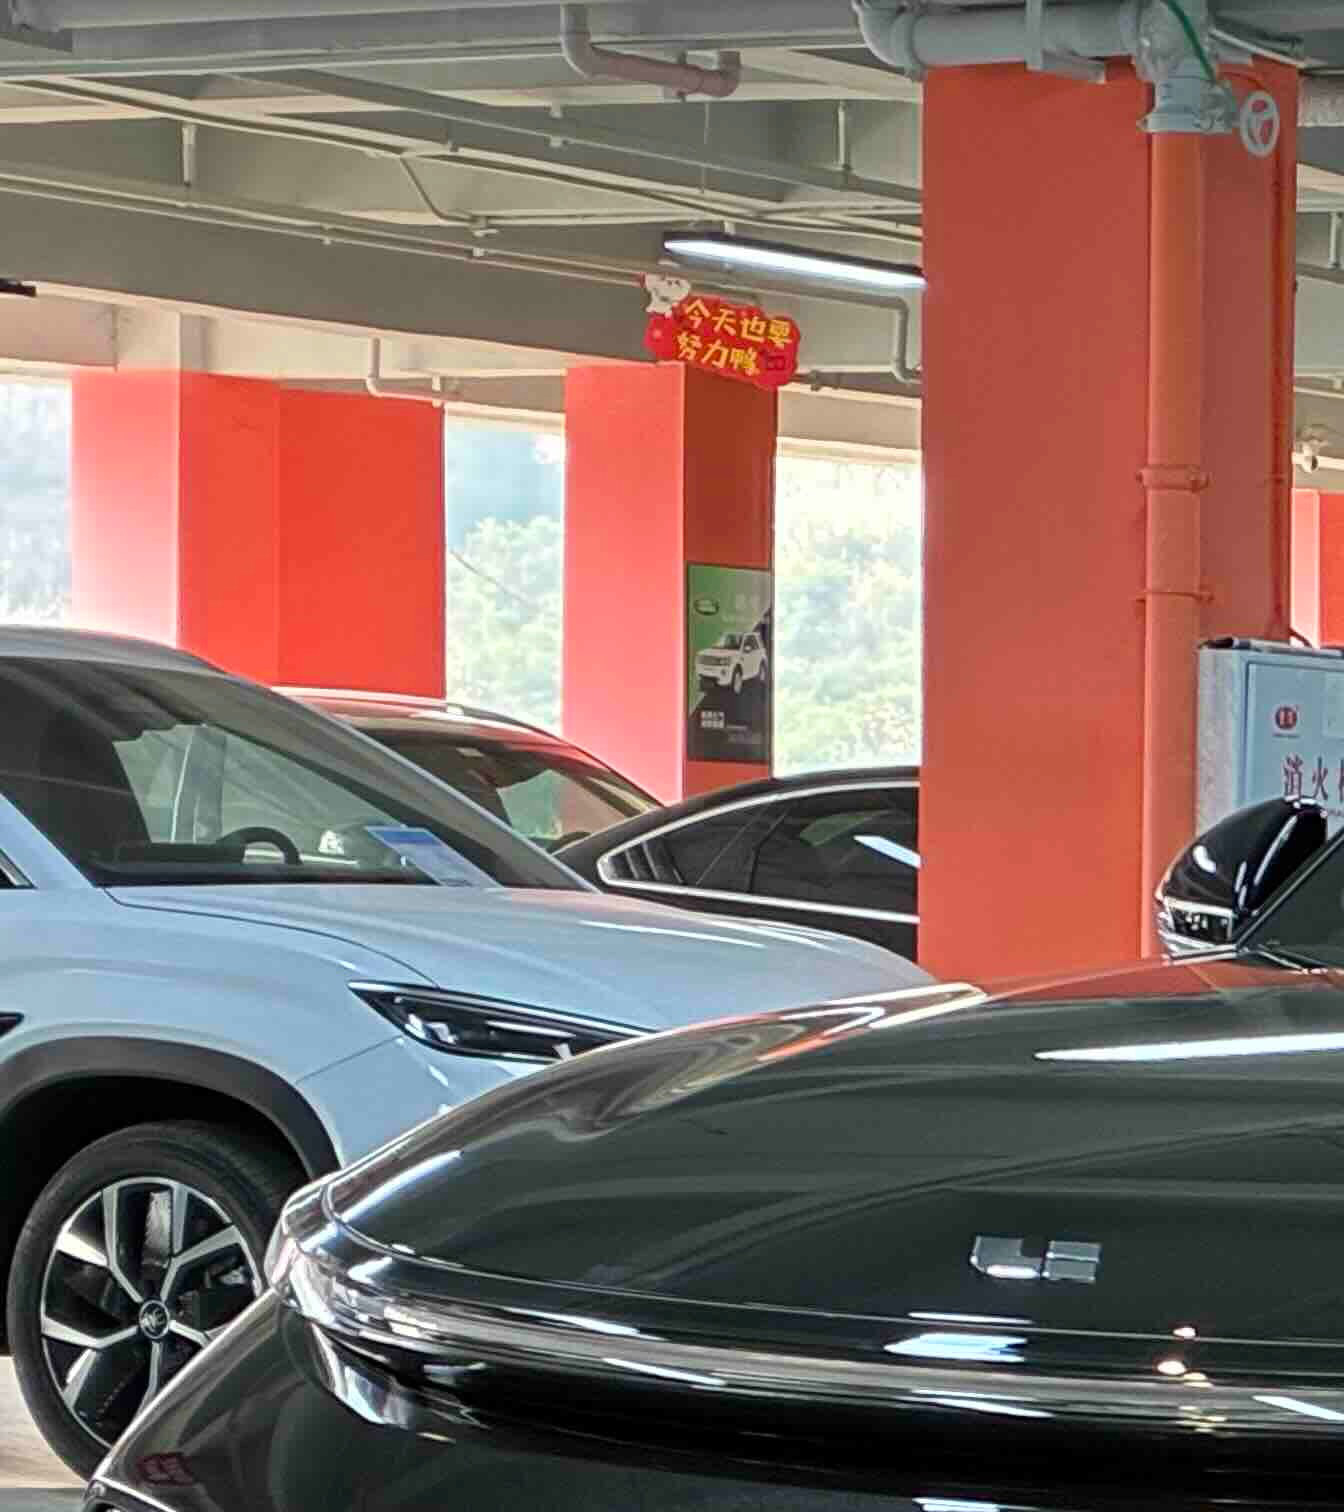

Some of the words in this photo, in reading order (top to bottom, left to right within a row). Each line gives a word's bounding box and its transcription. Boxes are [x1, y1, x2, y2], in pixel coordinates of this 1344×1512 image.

[684, 299, 792, 348] 今天也要
[675, 331, 760, 376] 努力鸭
